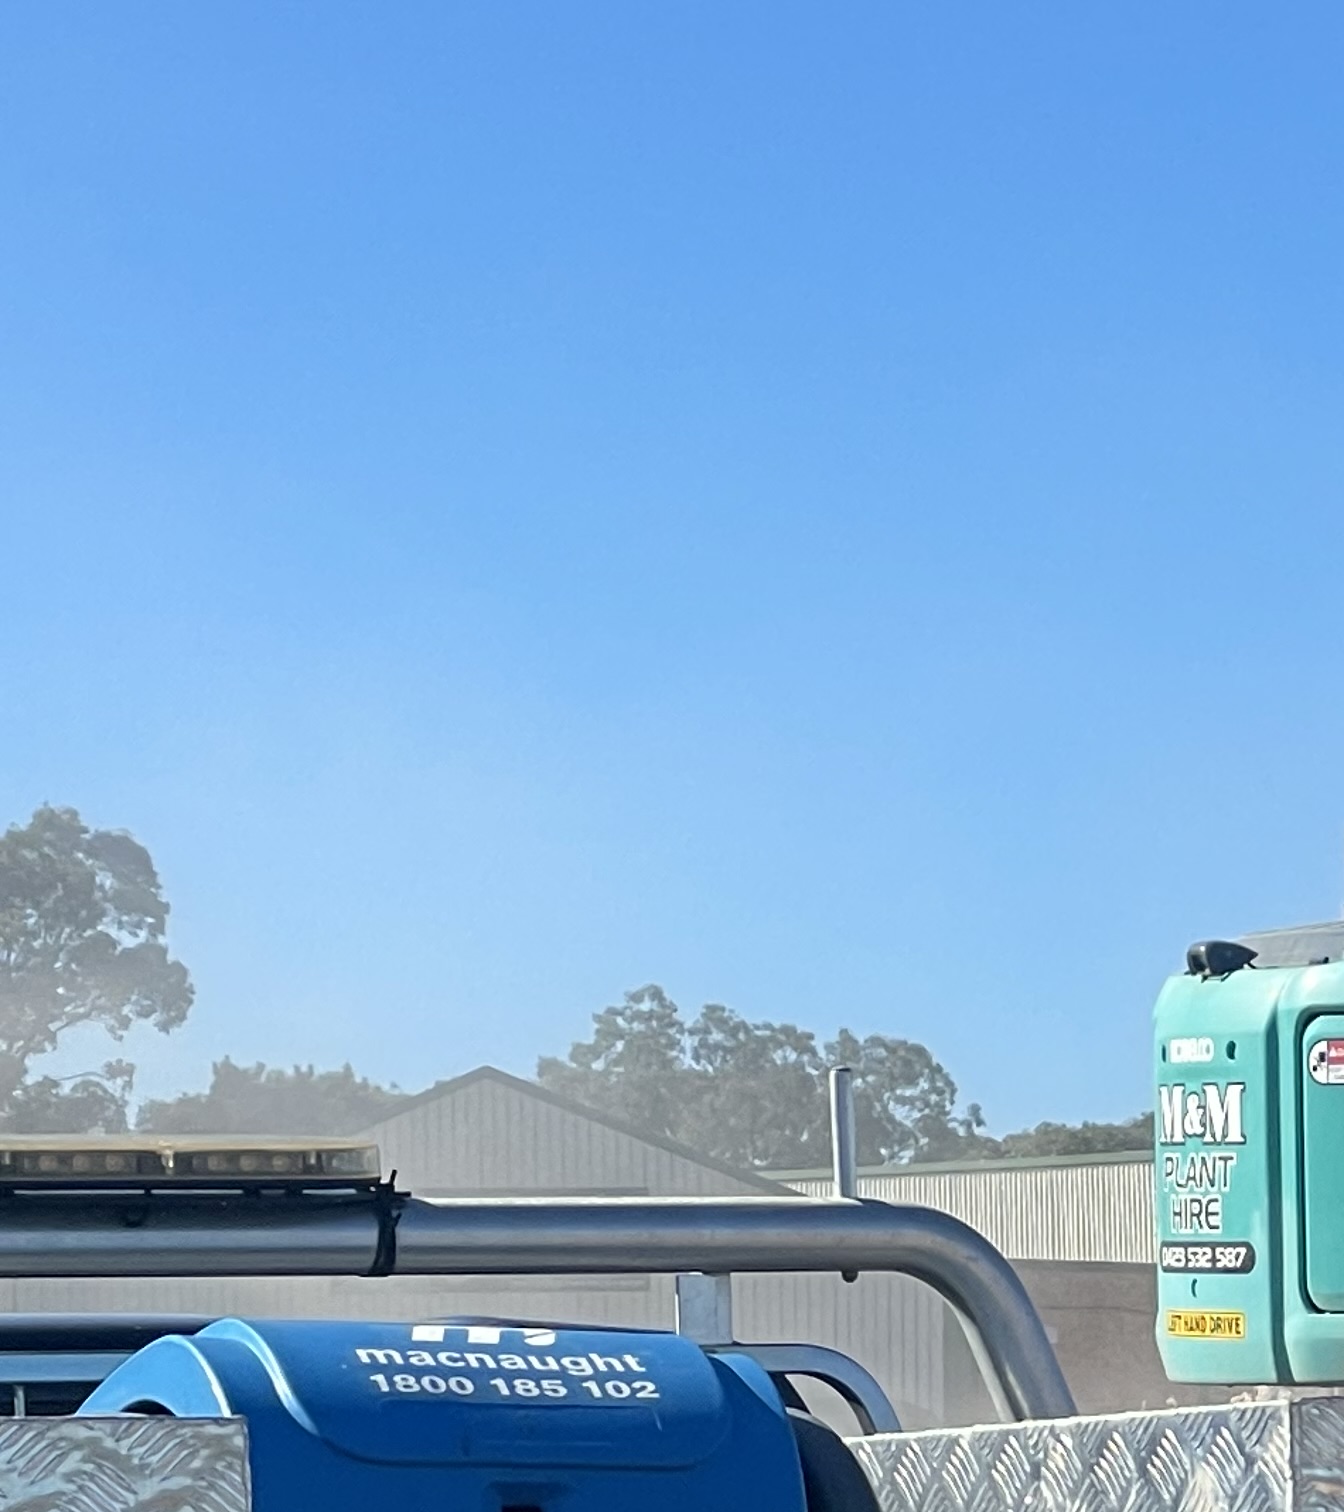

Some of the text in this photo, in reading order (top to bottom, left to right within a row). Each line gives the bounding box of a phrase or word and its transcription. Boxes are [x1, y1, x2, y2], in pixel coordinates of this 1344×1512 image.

[1159, 1082, 1246, 1145] M&M
[1163, 1152, 1237, 1192] PLANT
[1171, 1195, 1222, 1232] HIRE
[1187, 1246, 1212, 1268] 532
[1215, 1246, 1247, 1268] 587
[1209, 1315, 1242, 1335] DRIVE
[355, 1347, 648, 1376] macnaught
[369, 1373, 661, 1399] 1800 185 102
